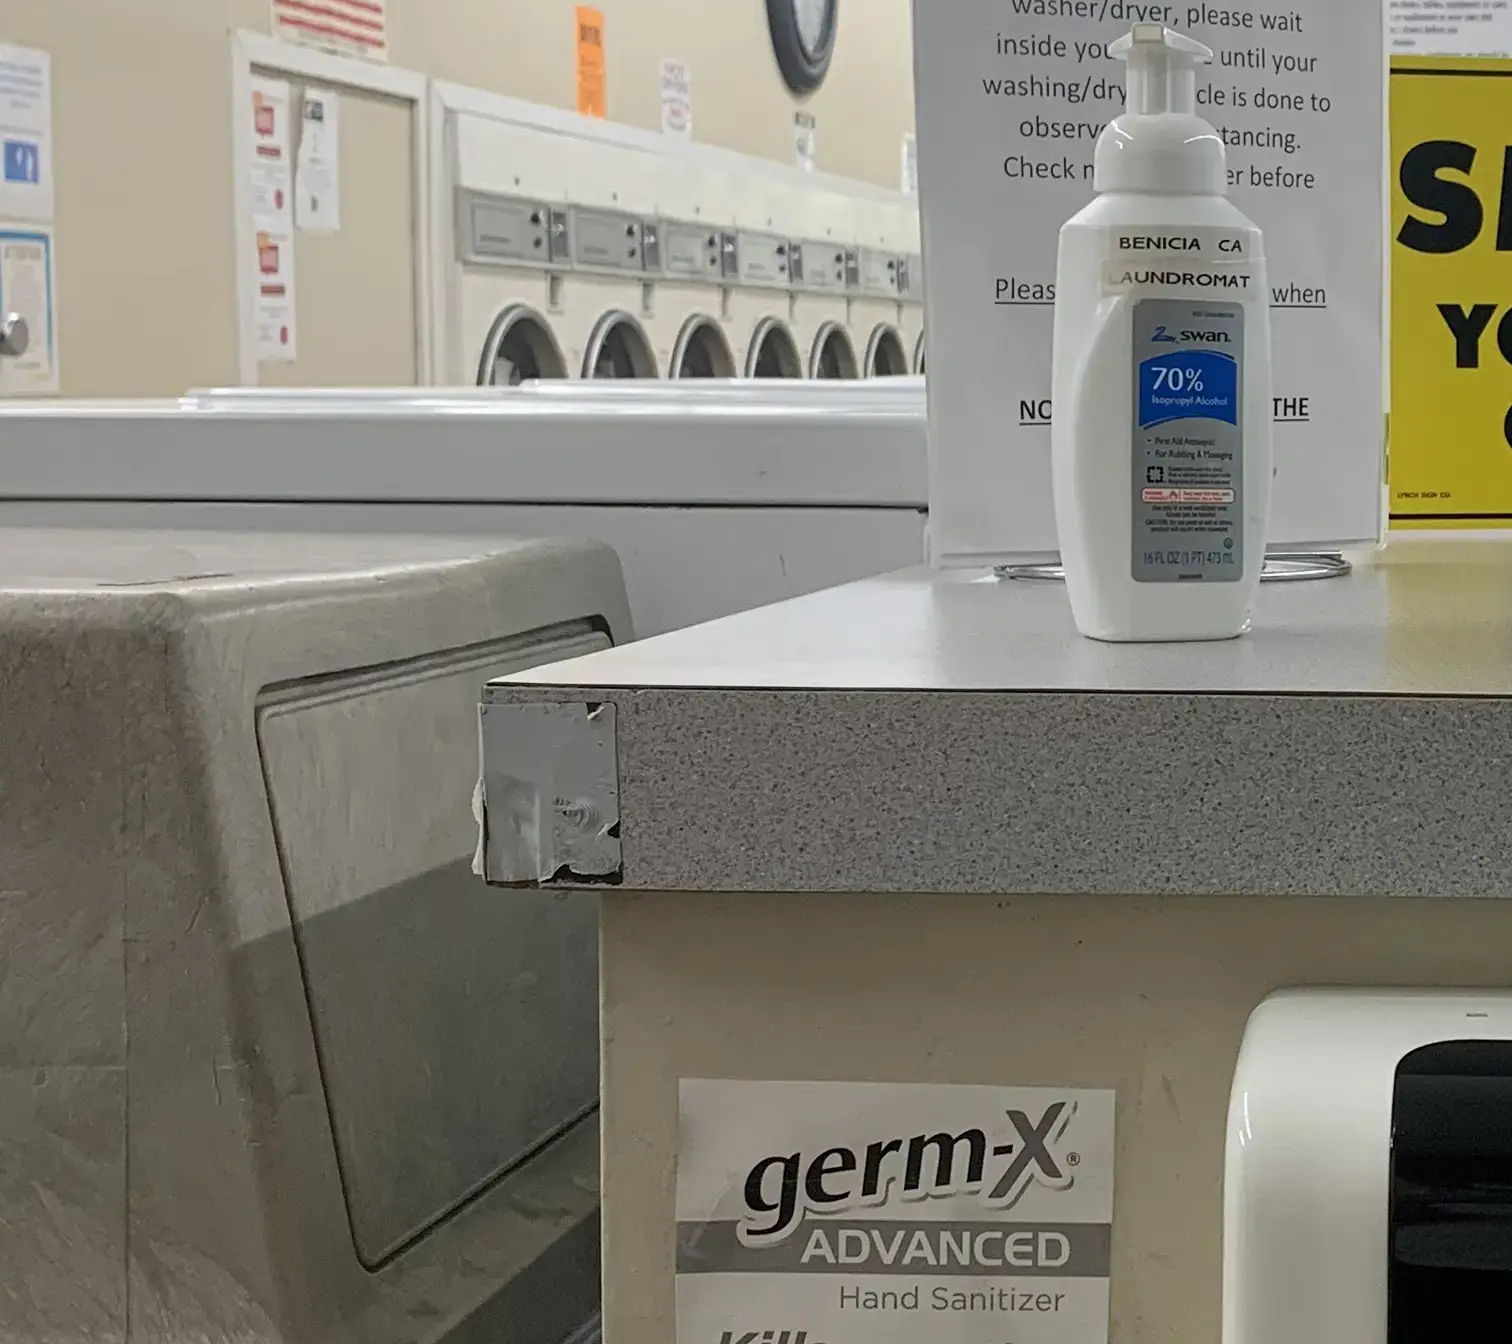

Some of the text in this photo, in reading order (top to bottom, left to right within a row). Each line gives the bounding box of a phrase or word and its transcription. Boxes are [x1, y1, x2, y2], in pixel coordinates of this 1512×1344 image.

[1187, 8, 1254, 29] please
[1260, 13, 1303, 33] wait
[996, 33, 1067, 58] inside
[1221, 47, 1266, 69] until
[1271, 54, 1318, 75] your
[1232, 86, 1247, 107] is
[1254, 87, 1304, 111] done
[1310, 93, 1331, 112] to
[1019, 117, 1106, 140] observ
[1003, 157, 1075, 181] Check
[1250, 165, 1315, 189] before
[1119, 236, 1242, 253] BENICIA CA
[995, 277, 1326, 304] Pleas when
[1108, 271, 1250, 288] LAUNDROMAT
[1151, 367, 1204, 392] 70%
[1151, 395, 1227, 406] Isopropyl Alcohol
[1273, 397, 1309, 417] THE
[1421, 491, 1438, 499] SIGN
[1143, 551, 1153, 565] 16
[1155, 551, 1165, 565] FL
[1167, 551, 1180, 565] OZ
[1206, 551, 1221, 565] 473
[800, 1229, 1070, 1267] ADVANCED
[840, 1286, 1066, 1313] Hand Sanitizer
